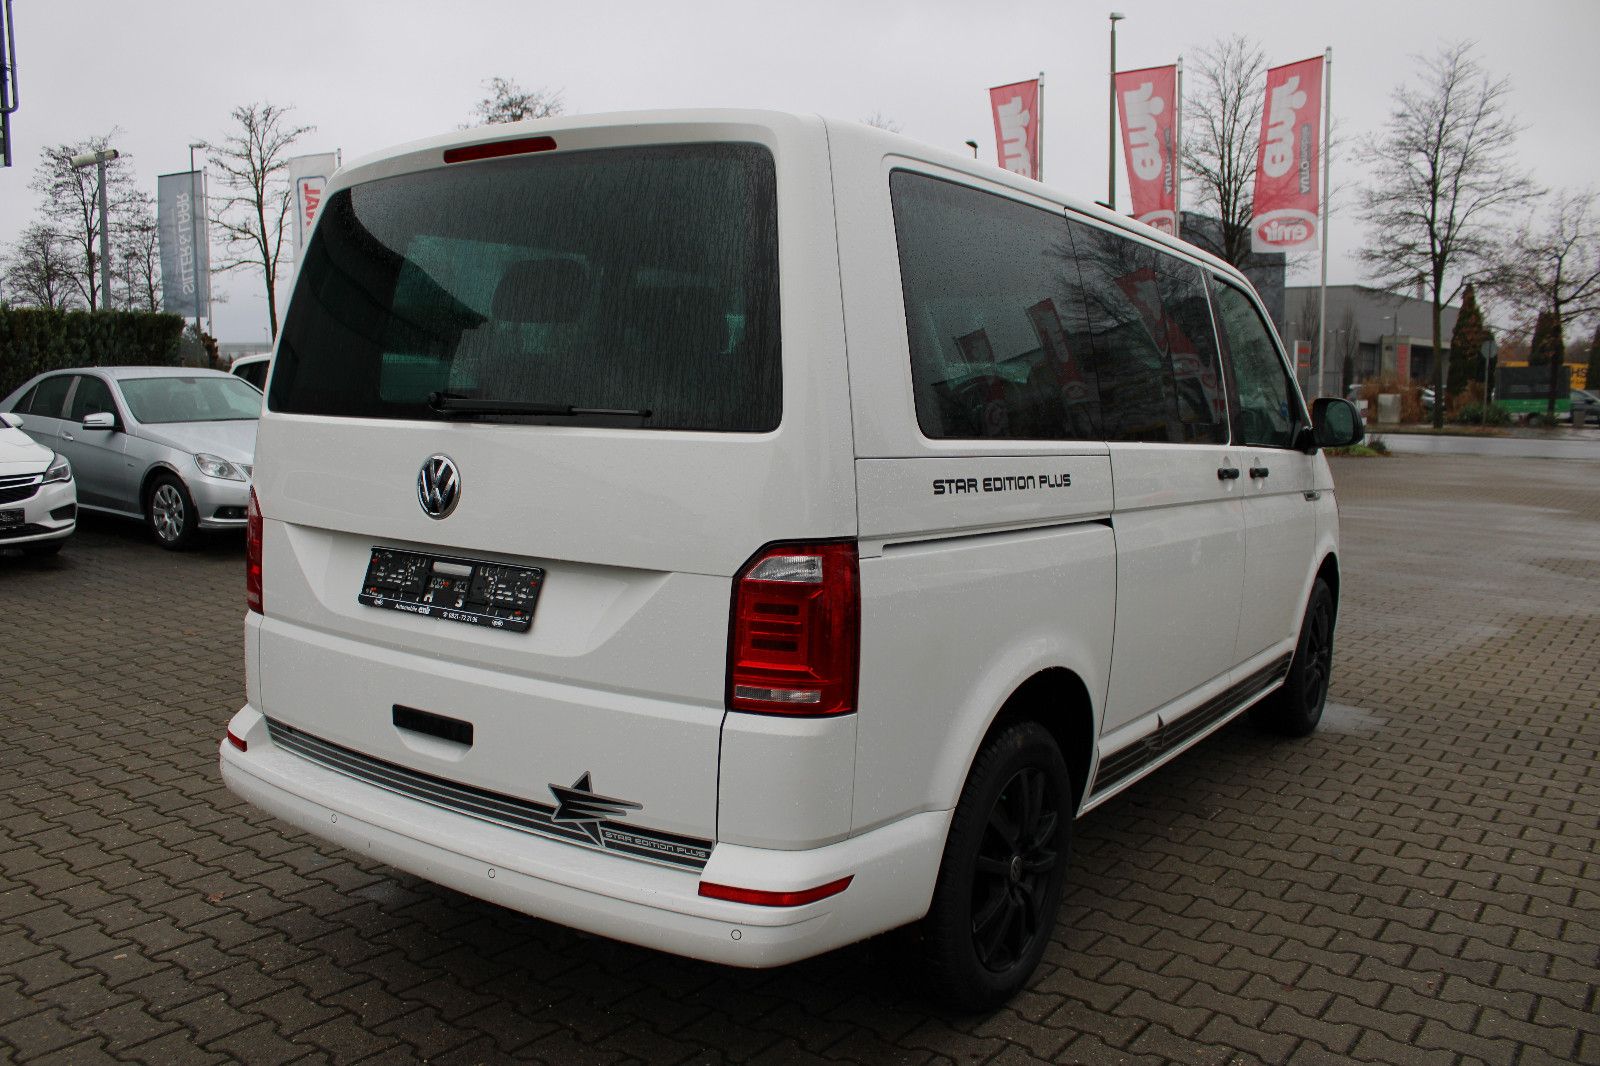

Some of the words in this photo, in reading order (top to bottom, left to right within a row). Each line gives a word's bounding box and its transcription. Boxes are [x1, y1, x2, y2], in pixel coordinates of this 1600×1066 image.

[932, 478, 978, 495] STAR
[982, 475, 1035, 492] EDITION
[1038, 473, 1072, 489] PLUS
[604, 831, 633, 844] STAR
[635, 837, 674, 852] EDITION
[676, 846, 706, 858] PLUS
